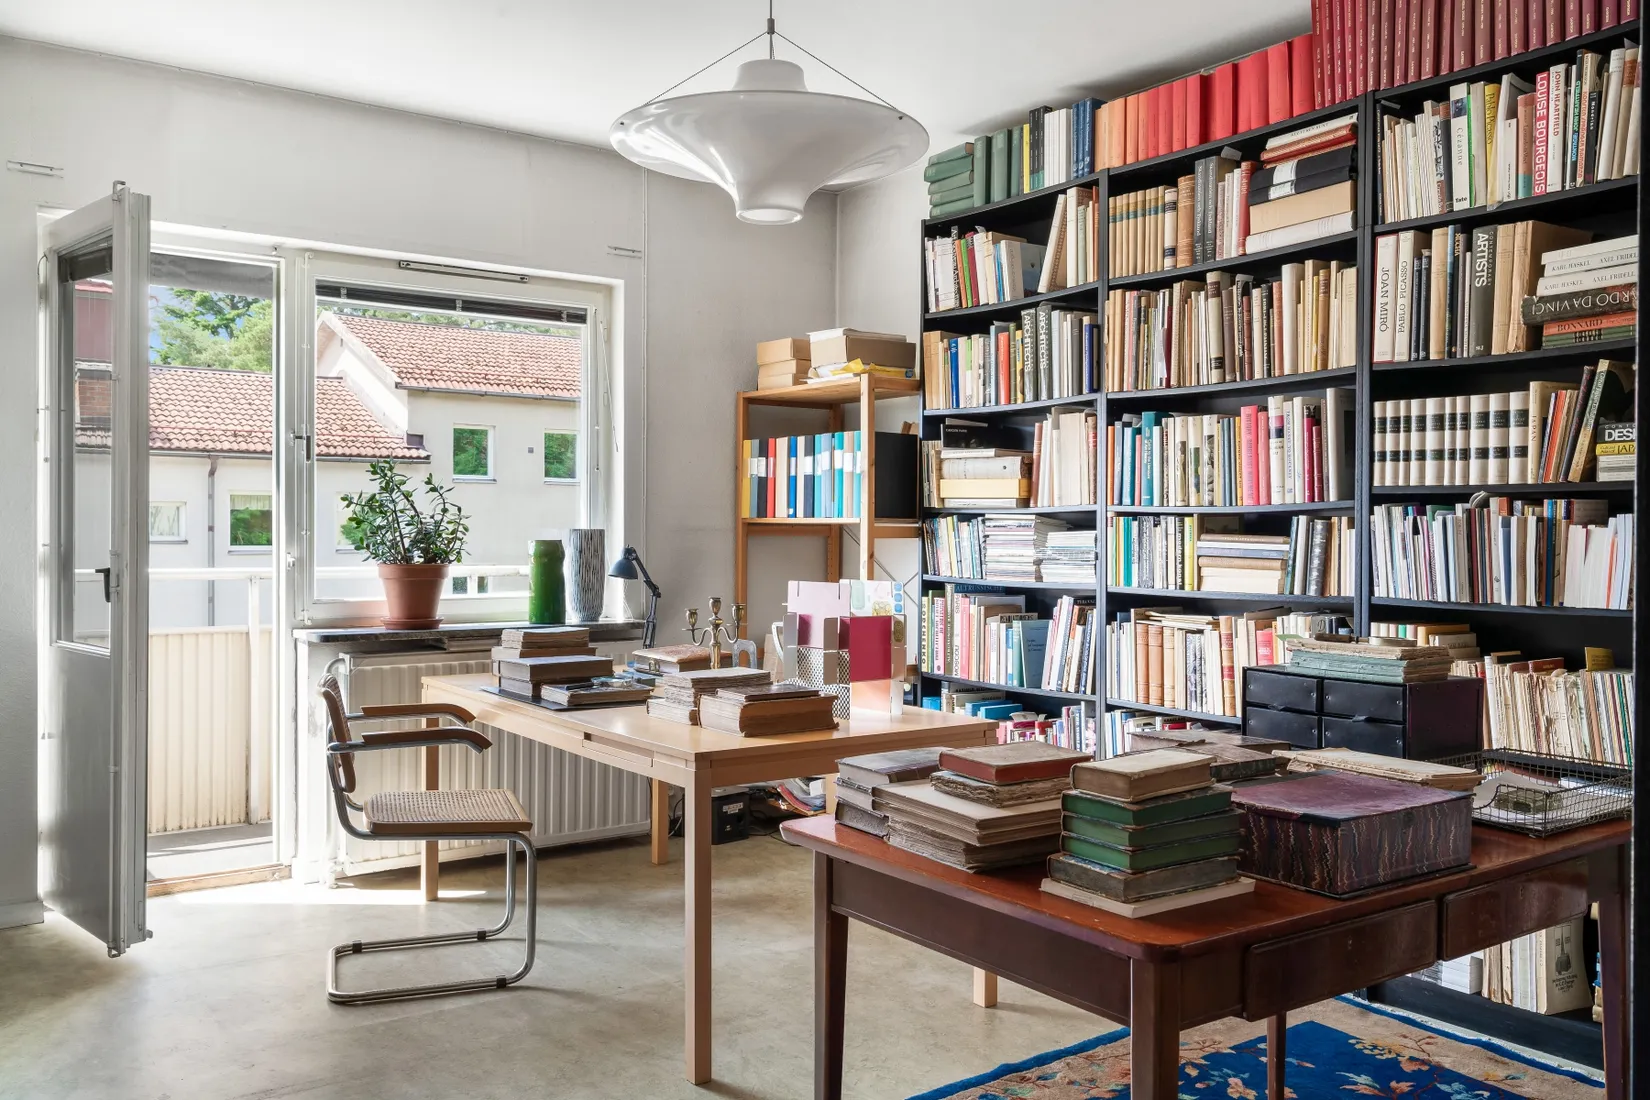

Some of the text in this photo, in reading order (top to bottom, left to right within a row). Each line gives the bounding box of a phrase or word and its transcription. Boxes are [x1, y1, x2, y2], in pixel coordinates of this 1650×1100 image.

[1486, 92, 1496, 145] Pablo Picasso
[1535, 73, 1548, 193] LOUISE BOURGEOIS
[1553, 95, 1561, 136] HEARTFIELD
[1456, 127, 1464, 166] Cézanne
[1475, 233, 1488, 287] ARTISTS
[1600, 256, 1614, 264] AXEL
[1610, 271, 1636, 280] FRIDELL
[1379, 267, 1390, 332] JOAN MIRÓ
[1397, 261, 1408, 333] PABLO PICASSO
[1532, 300, 1570, 315] VINCI
[1573, 295, 1592, 308] DA
[1557, 319, 1603, 332] BONNARD
